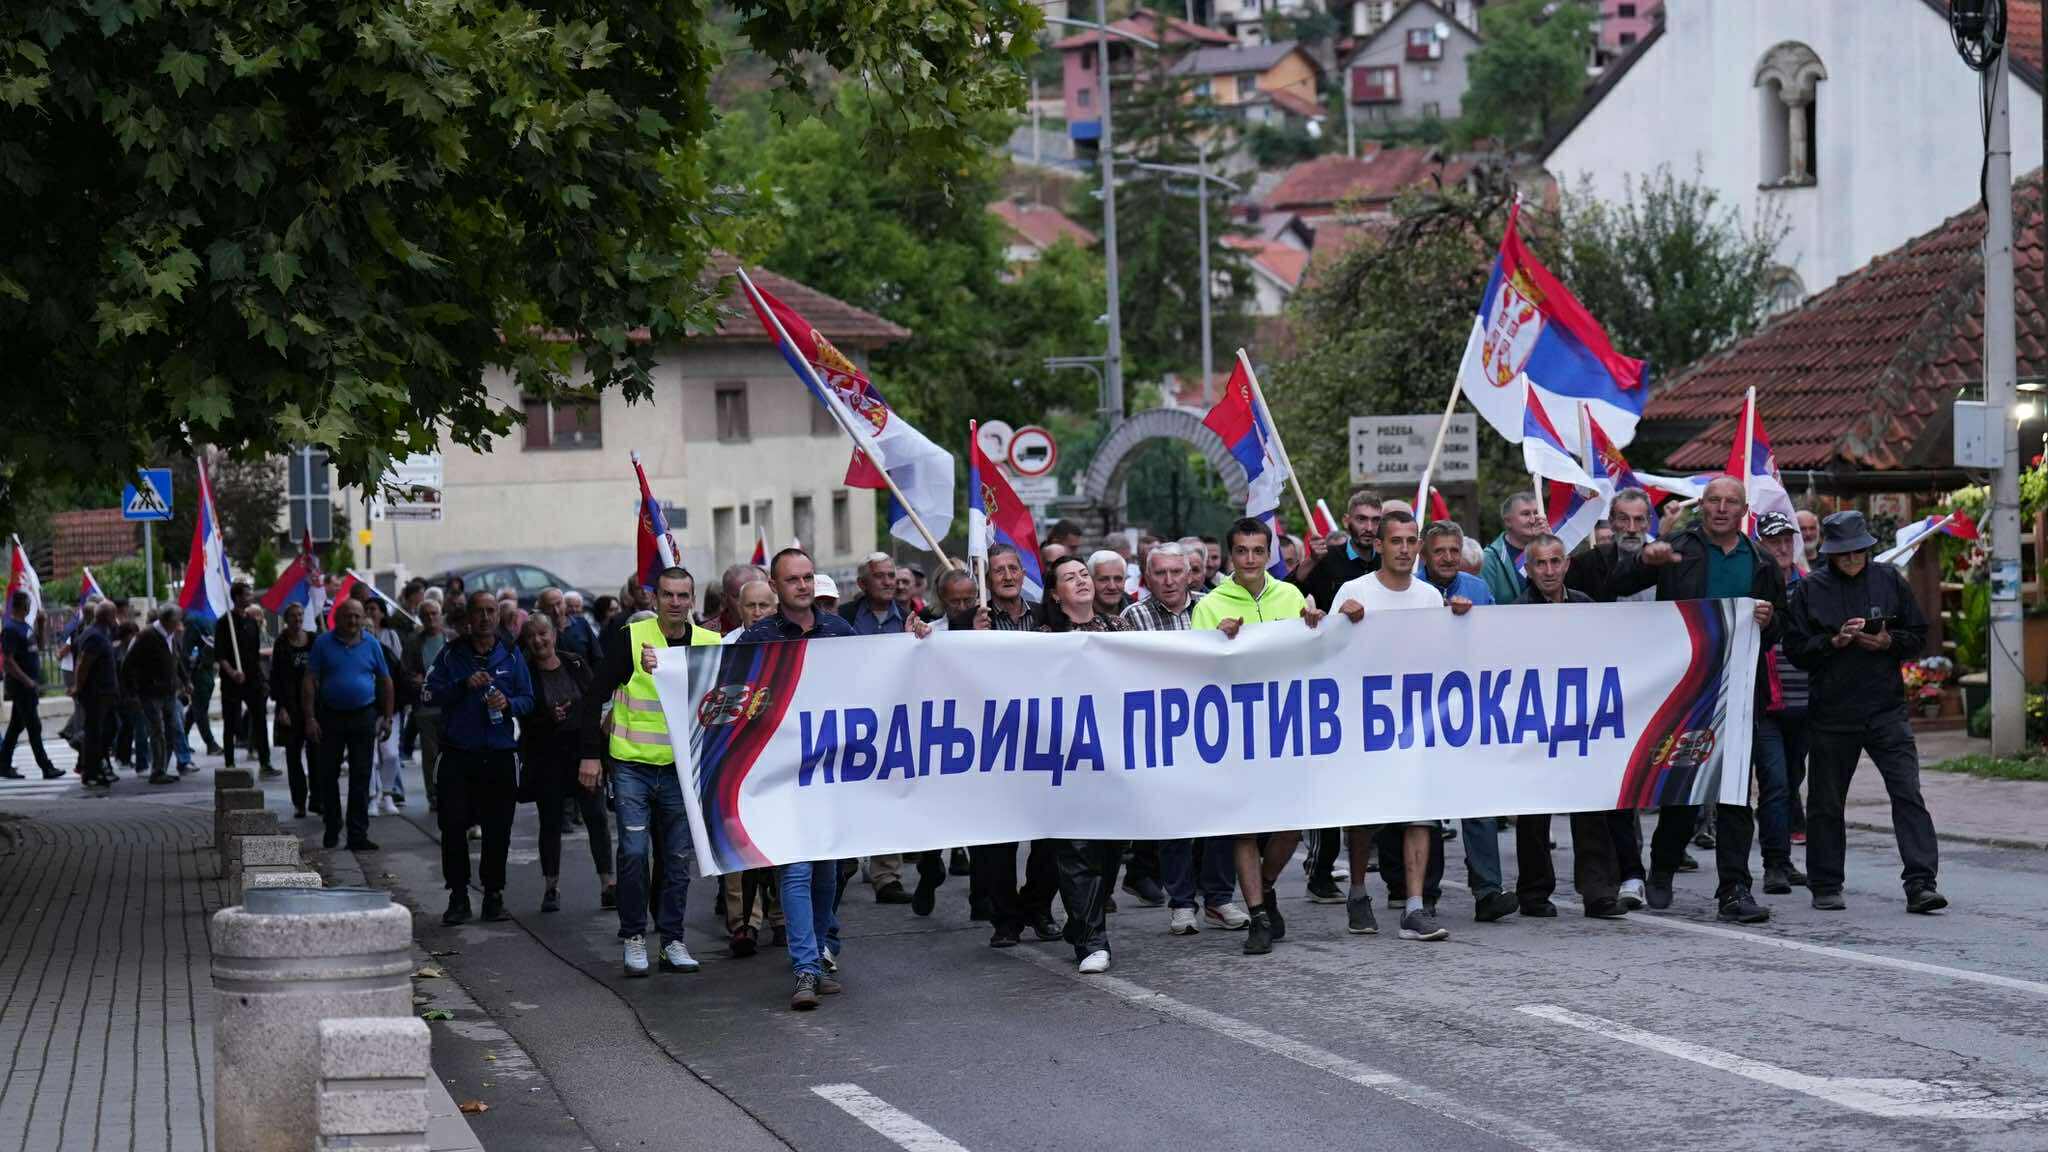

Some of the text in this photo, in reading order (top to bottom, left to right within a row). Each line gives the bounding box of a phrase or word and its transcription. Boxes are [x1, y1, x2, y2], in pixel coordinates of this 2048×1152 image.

[798, 666, 1626, 788] ИВАЊИЦА ПРОТИВ БЛОКАДА
